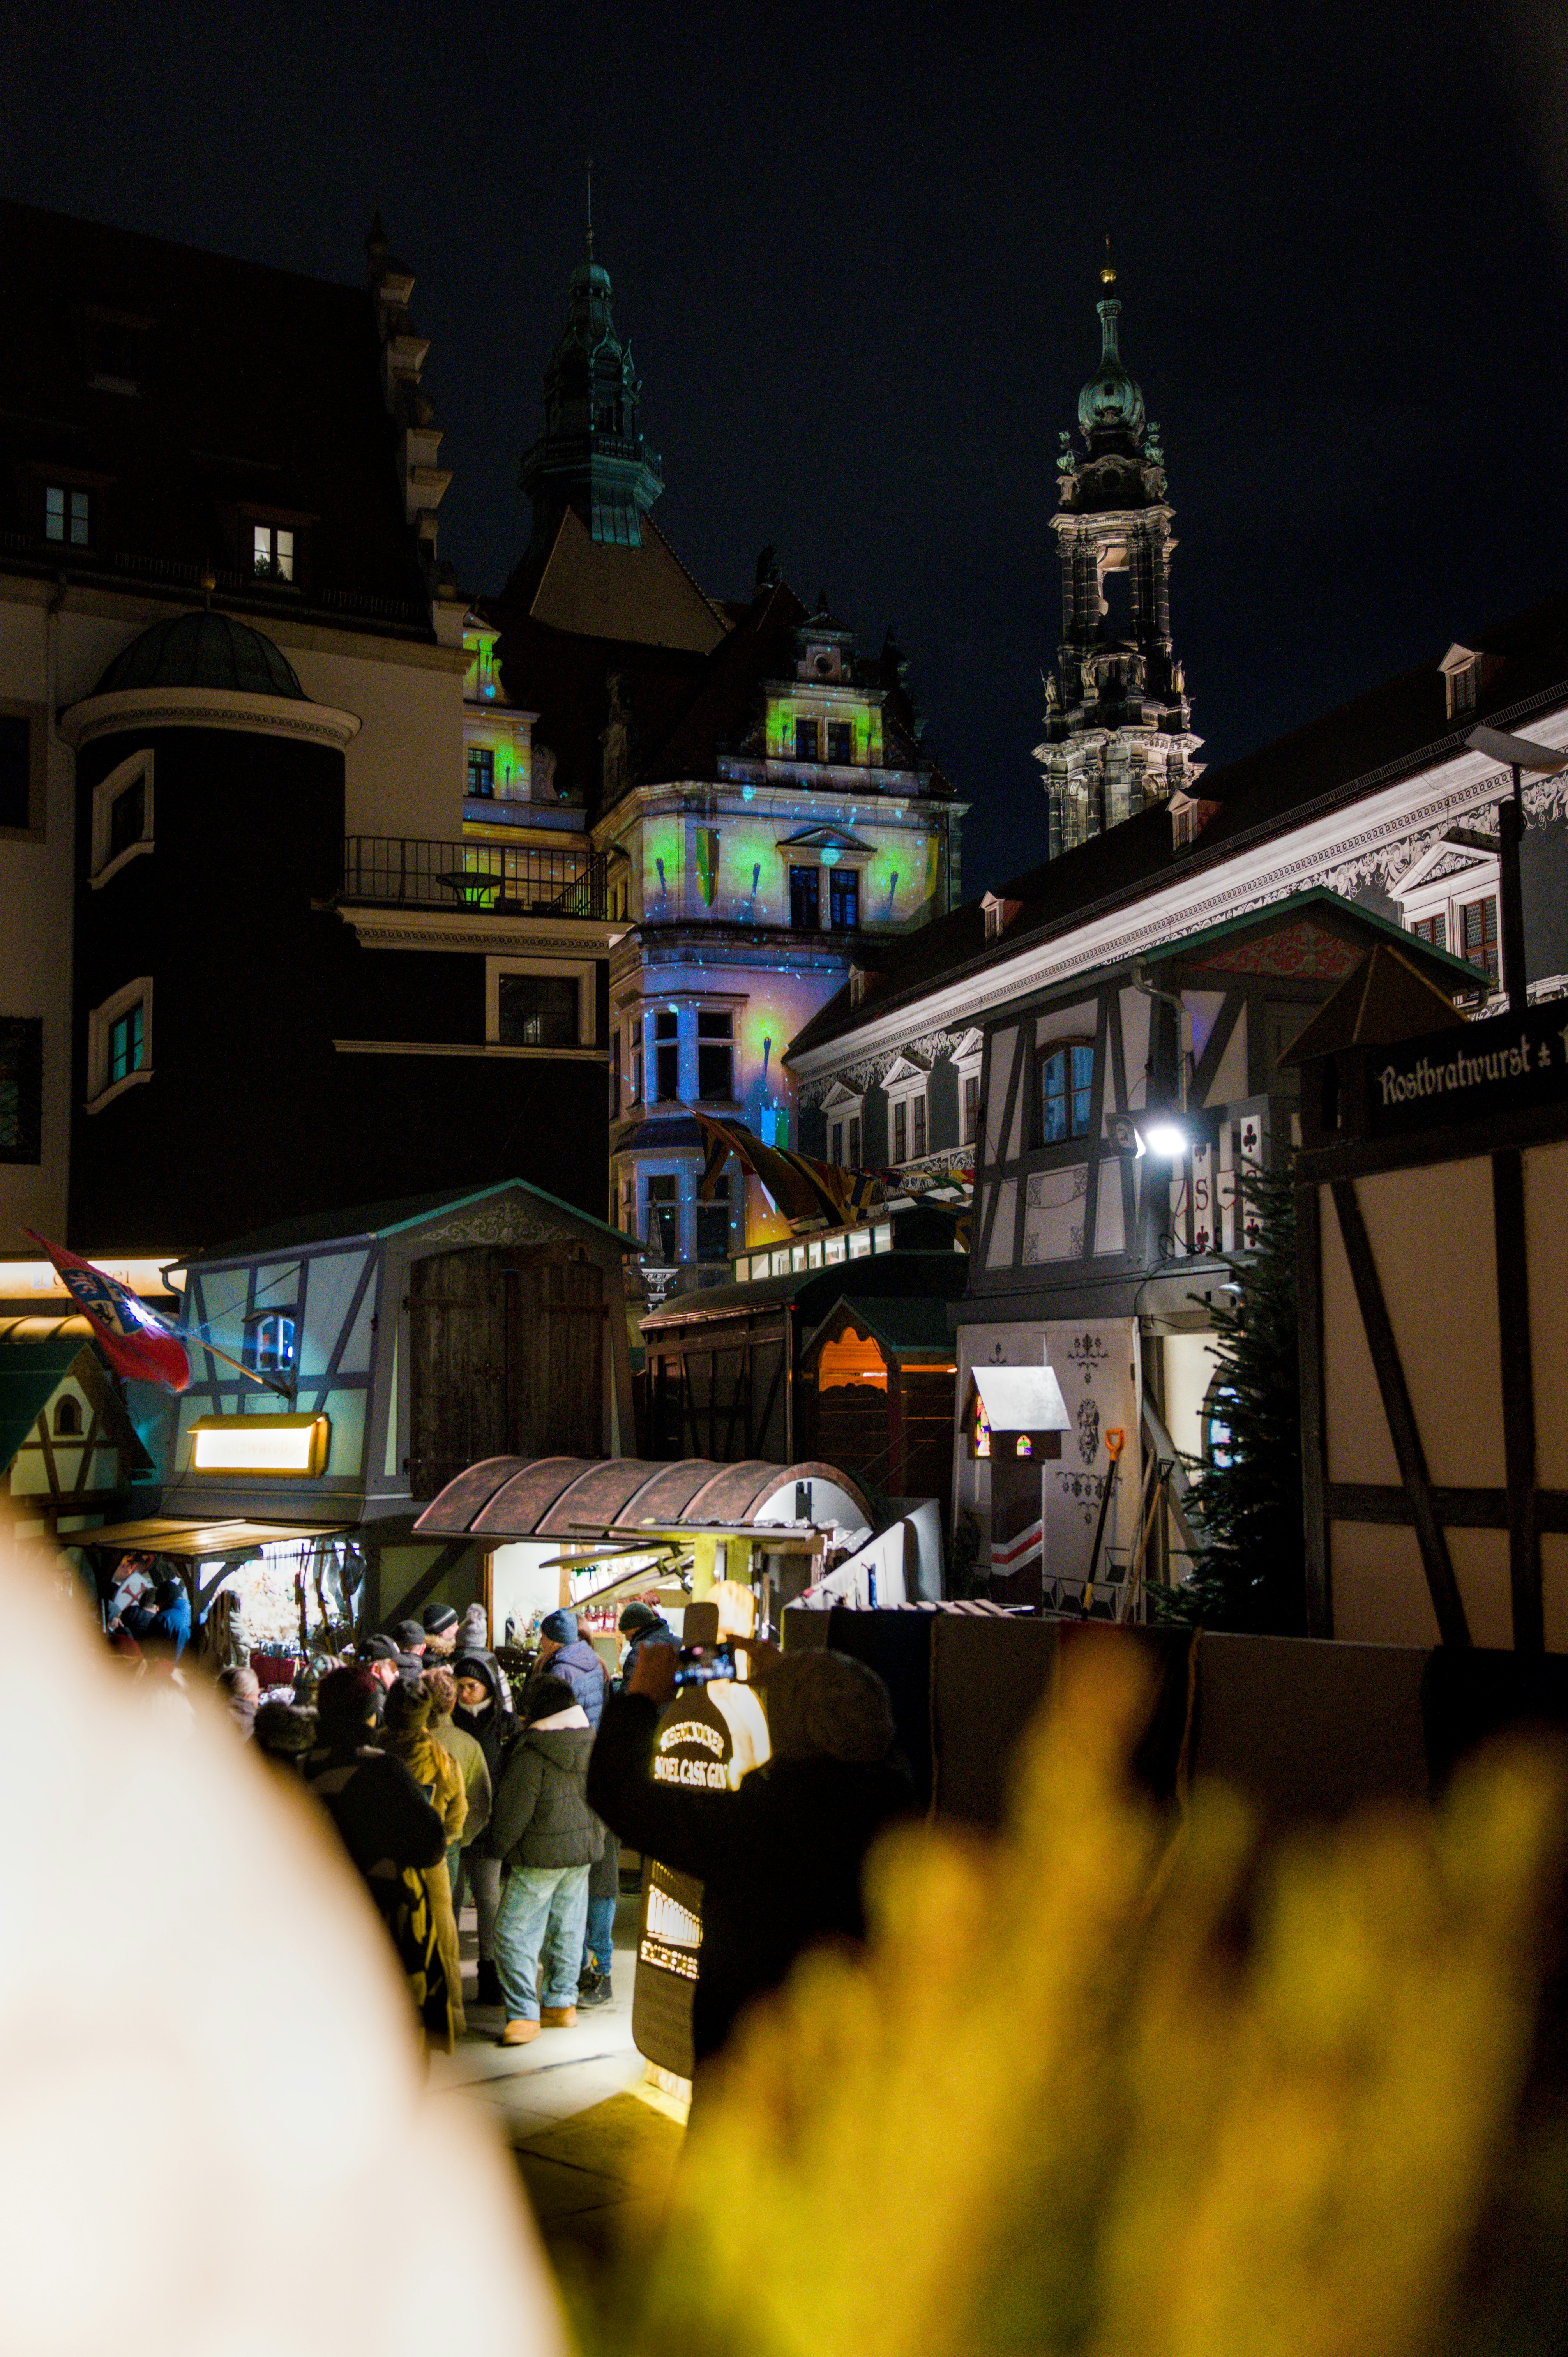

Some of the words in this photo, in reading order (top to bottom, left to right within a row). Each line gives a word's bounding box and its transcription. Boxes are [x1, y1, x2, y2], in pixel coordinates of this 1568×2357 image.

[1379, 1034, 1531, 1104] Rostbratwurst
[680, 1759, 708, 1786] CASK
[707, 1762, 728, 1790] GIN
